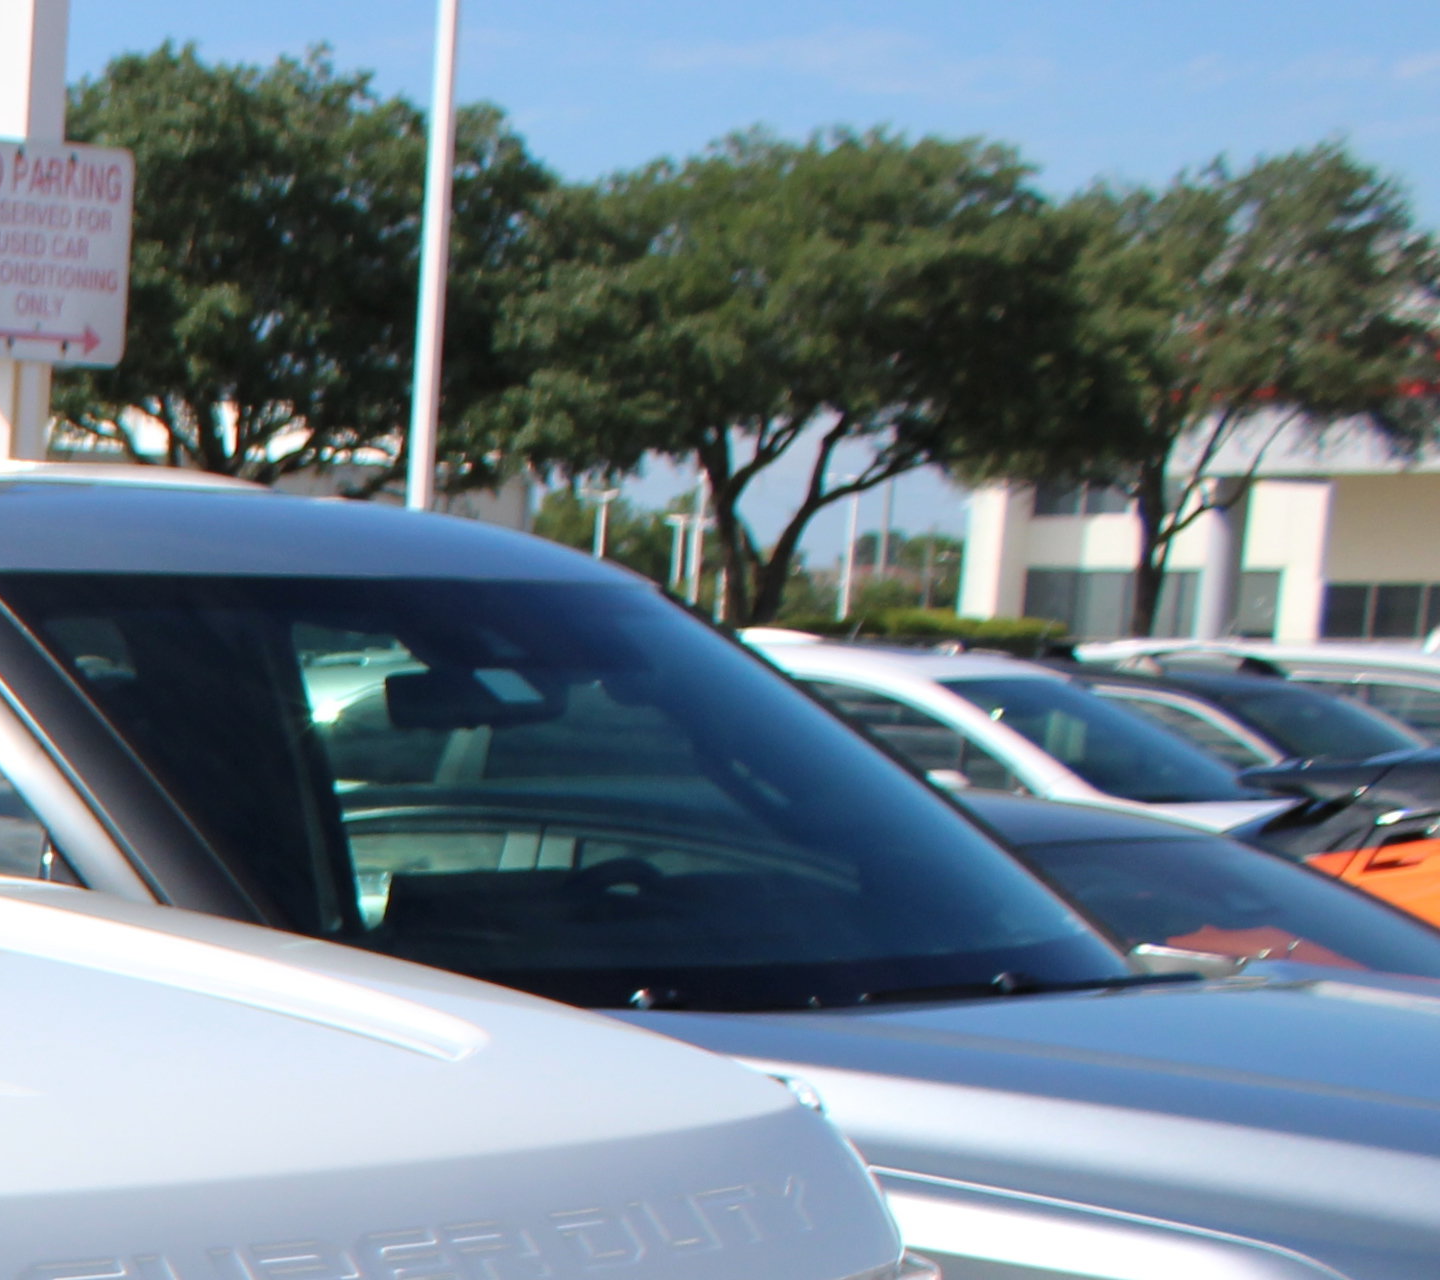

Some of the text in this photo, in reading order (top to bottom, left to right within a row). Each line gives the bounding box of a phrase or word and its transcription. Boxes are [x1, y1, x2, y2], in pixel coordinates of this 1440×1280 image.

[11, 154, 123, 204] PARKING
[76, 206, 113, 234] FOR
[51, 234, 89, 261] CAR
[14, 290, 66, 319] ONLY
[548, 1172, 814, 1273] DUTY
